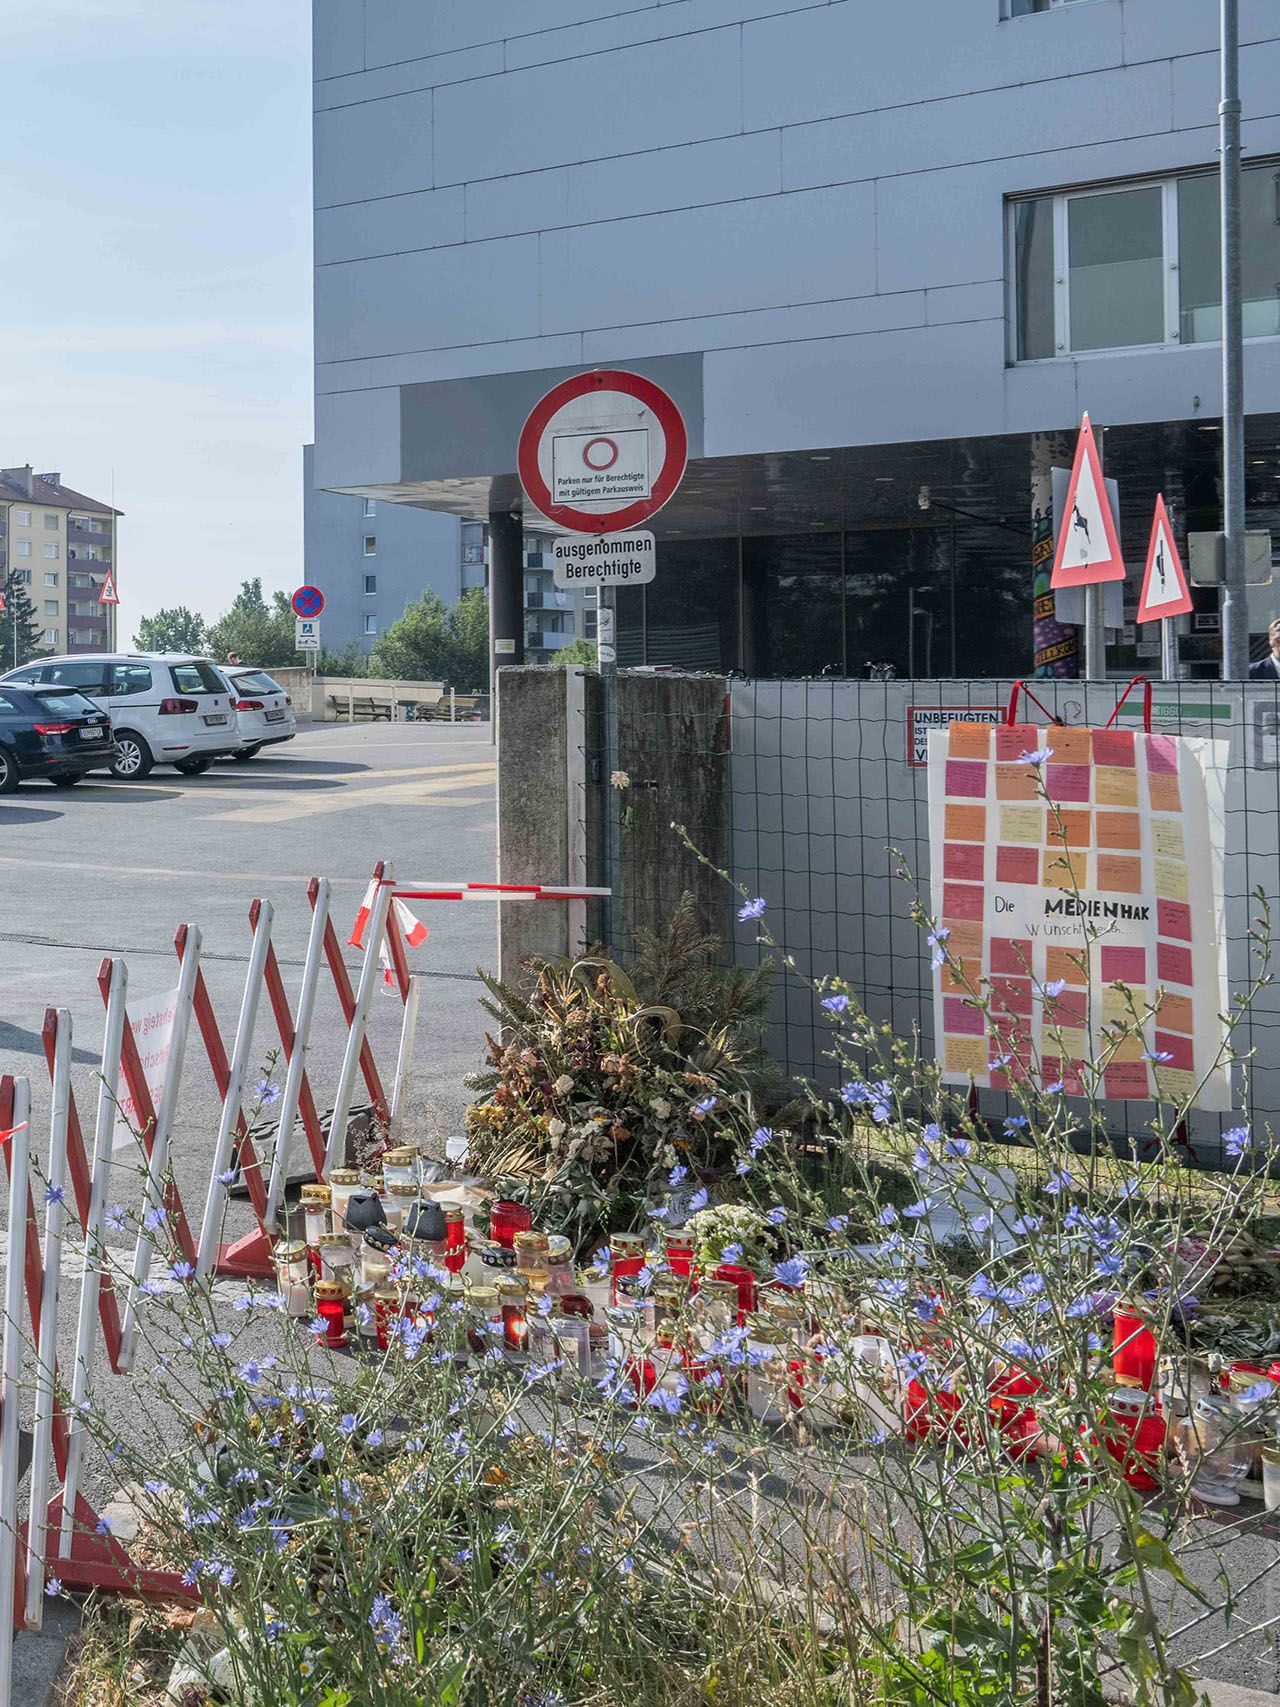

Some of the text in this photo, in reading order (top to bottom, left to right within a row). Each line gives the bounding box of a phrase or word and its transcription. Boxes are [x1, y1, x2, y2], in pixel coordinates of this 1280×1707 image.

[557, 472, 645, 485] Parken nur für Berechtigte
[558, 483, 644, 498] mit gültigem Parkausweis
[555, 538, 652, 561] ausgenommen
[566, 559, 642, 579] Berechtigte
[914, 712, 999, 724] UNBEFUGTEN
[914, 727, 927, 735] IST
[994, 896, 1150, 920] Die MEDIENHAK
